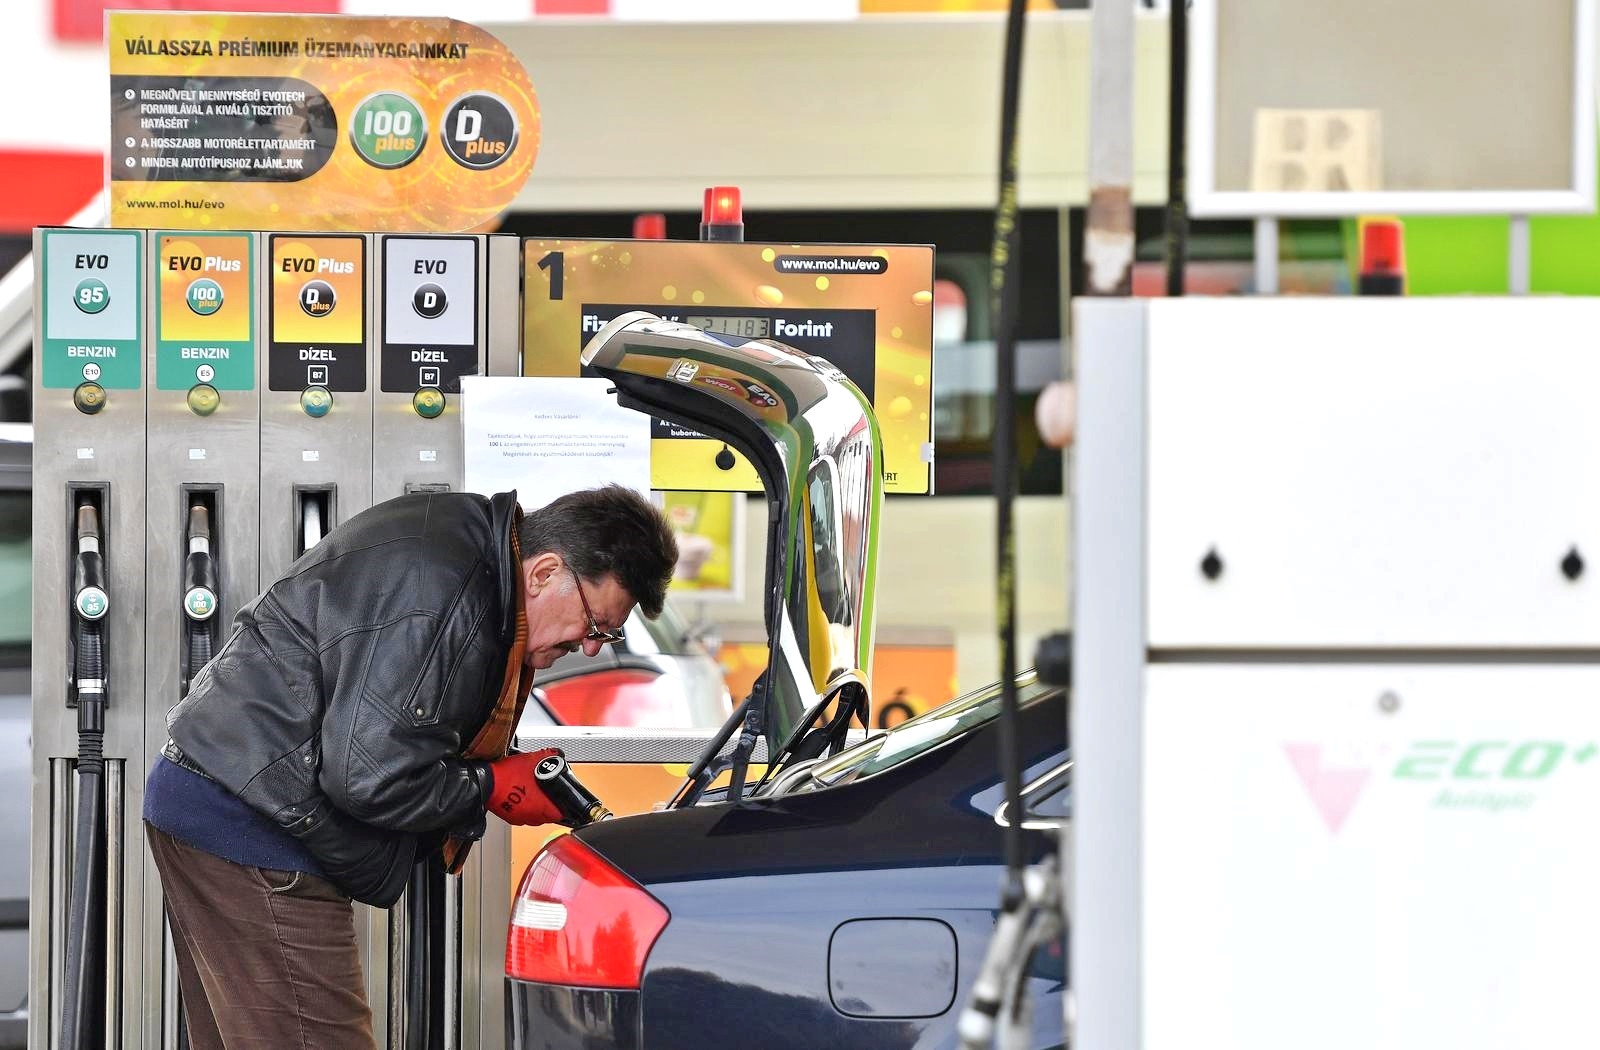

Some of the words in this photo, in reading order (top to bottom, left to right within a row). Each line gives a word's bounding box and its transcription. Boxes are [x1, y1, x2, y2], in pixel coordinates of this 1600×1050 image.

[125, 36, 213, 56] VÁLASSZA
[218, 36, 299, 57] PRÉMIUM
[304, 38, 469, 59] ÜZEMANYAGAINKAT
[141, 88, 196, 101] MEGNÖVELT
[262, 91, 305, 102] EVOTECH
[141, 102, 203, 115] FORMULÁVAL
[206, 105, 216, 115] A
[216, 102, 249, 115] KIVÁLÓ
[251, 103, 293, 116] TISZTÍTÓ
[141, 115, 189, 129] HATÁSÉRT
[364, 110, 412, 136] 100
[455, 109, 482, 141] D
[141, 137, 149, 148] A
[151, 137, 201, 149] HOSSZABB
[204, 137, 316, 150] MOTORÉLETTARTAMÉRT
[375, 132, 416, 155] plus
[465, 137, 506, 158] plus
[141, 157, 178, 168] MINDEN
[181, 156, 254, 168] AUTÓTÍPUSHOZ
[254, 157, 303, 170] AJÁNLJUK
[127, 200, 225, 209] www.mol.hu/evo
[75, 254, 109, 269] EVO
[169, 256, 201, 271] EVO
[204, 256, 241, 272] Plus
[282, 258, 315, 272] EVO
[318, 258, 354, 274] Plus
[414, 259, 447, 275] EVO
[782, 259, 880, 271] www.mol.hu/evo
[537, 251, 564, 300] 1
[80, 287, 104, 304] 95
[192, 287, 217, 300] 100
[306, 288, 319, 304] D
[423, 293, 436, 308] D
[198, 299, 218, 308] plus
[311, 301, 330, 311] plus
[775, 319, 833, 337] Forint
[67, 346, 116, 357] BENZIN
[181, 348, 230, 359] BENZIN
[299, 347, 336, 361] DÍZEL
[411, 348, 448, 362] DÍZEL
[85, 368, 99, 376] E10
[424, 373, 434, 381] B7
[87, 603, 99, 611] 95
